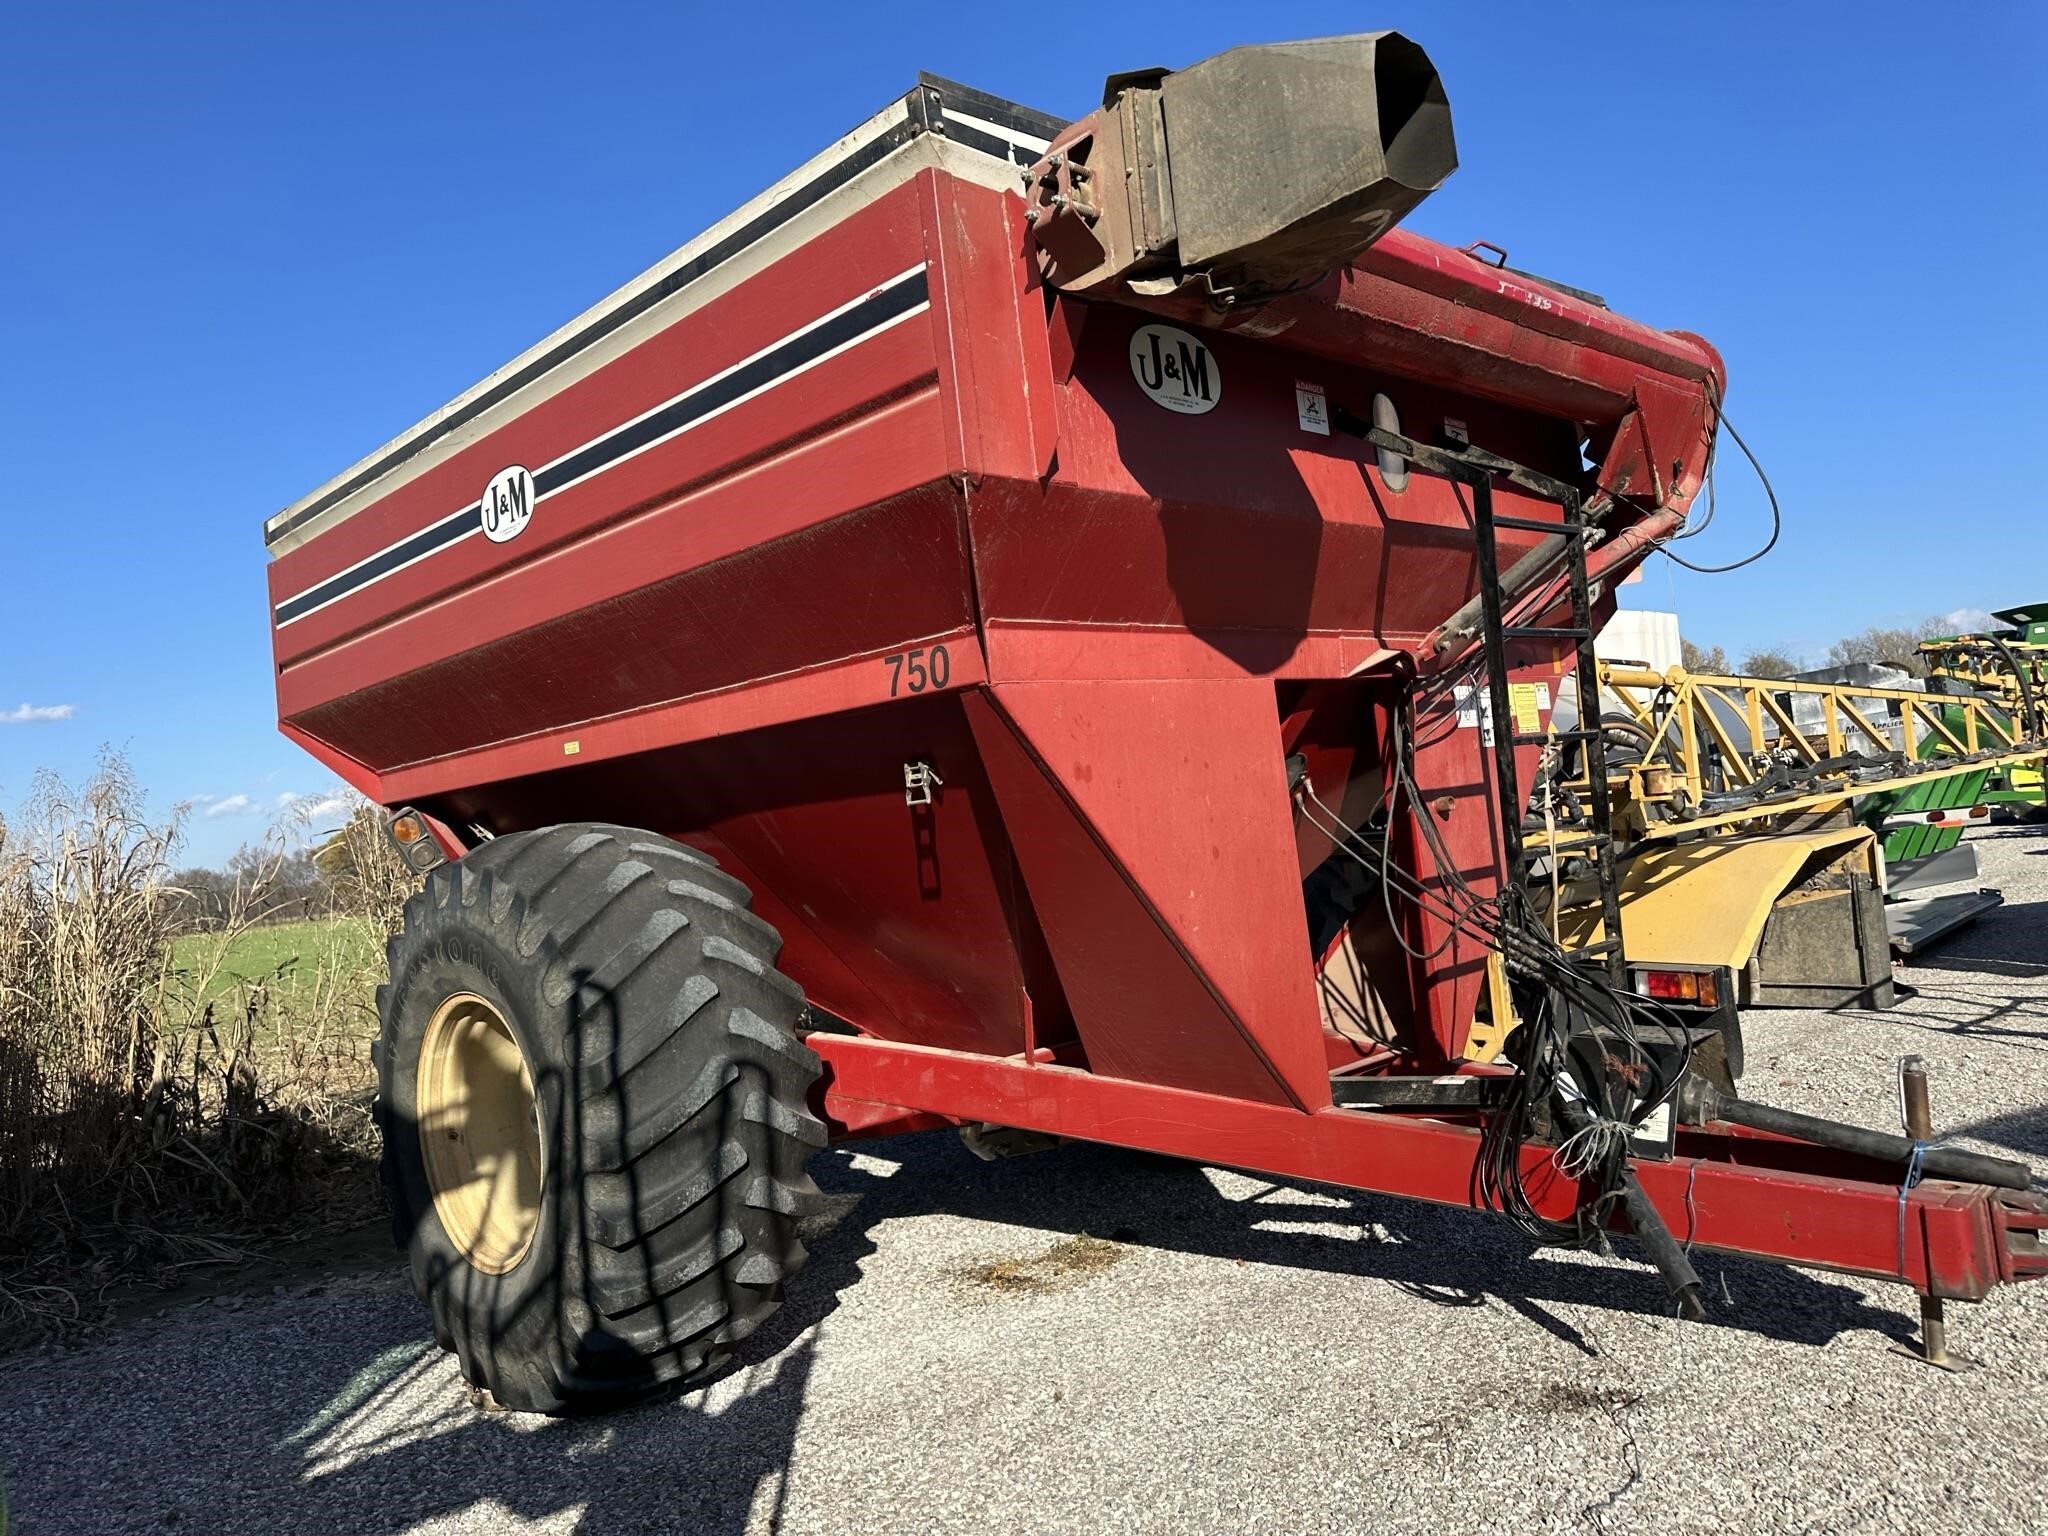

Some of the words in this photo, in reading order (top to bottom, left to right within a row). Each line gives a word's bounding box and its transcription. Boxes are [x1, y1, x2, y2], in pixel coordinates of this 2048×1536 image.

[1136, 333, 1213, 401] J&M
[485, 471, 528, 532] J&M
[884, 645, 949, 697] 750
